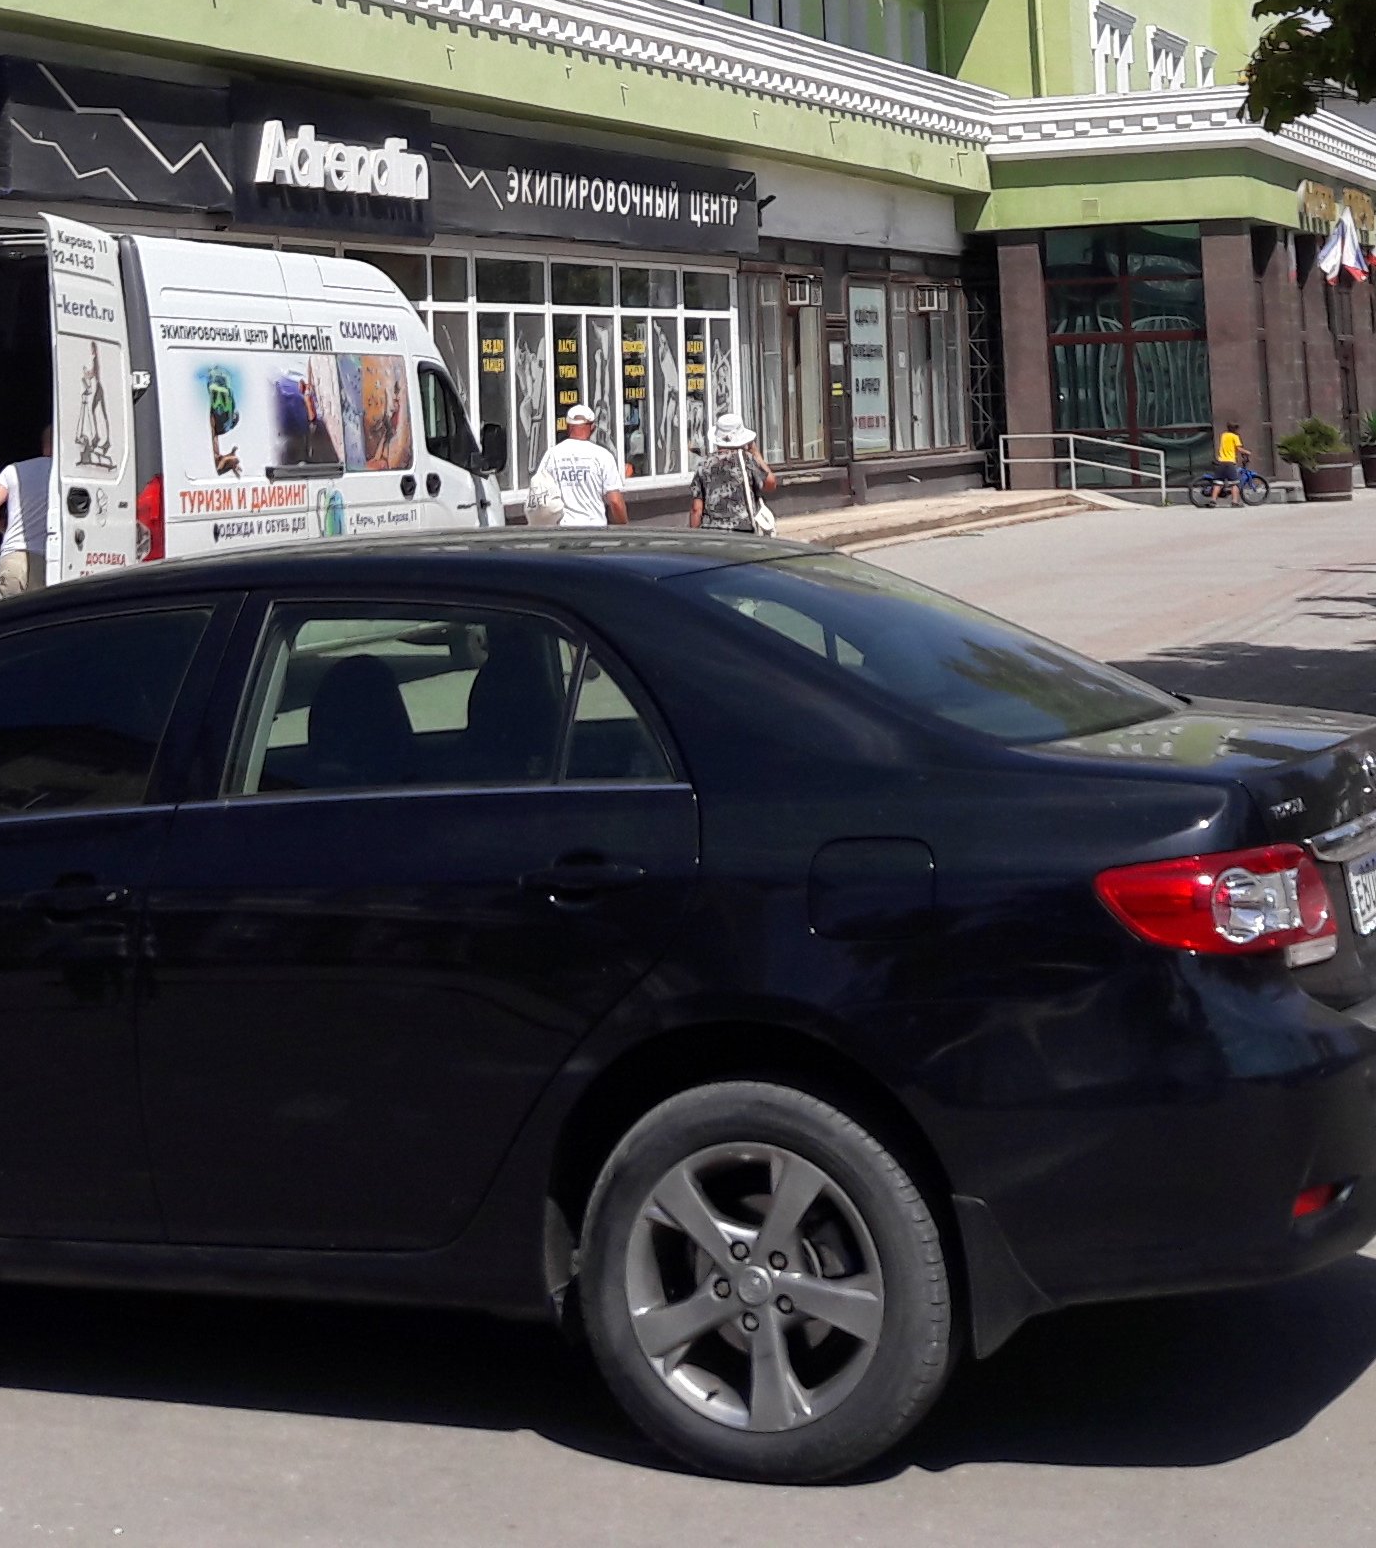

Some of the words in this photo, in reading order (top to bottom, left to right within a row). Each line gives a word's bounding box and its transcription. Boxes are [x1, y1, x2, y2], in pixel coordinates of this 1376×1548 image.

[255, 117, 430, 201] Adrenalin
[505, 164, 680, 221] ЭКИПИРОВОЧНЫЙ
[688, 189, 739, 228] ЦЕНТР
[56, 294, 115, 323] -kerch.ru
[160, 323, 242, 343] ЭКИПИРОВОЧНЫЙ
[244, 328, 269, 346] ЦЕНТР
[272, 323, 333, 352] Adrenalin
[339, 320, 398, 343] СКАЛОДРОМ
[179, 488, 234, 514] ТУРИЗМ
[237, 486, 247, 510] И
[218, 522, 255, 540] ОДЕЖДА
[257, 520, 264, 535] И
[265, 518, 290, 535] ОБУВЬ
